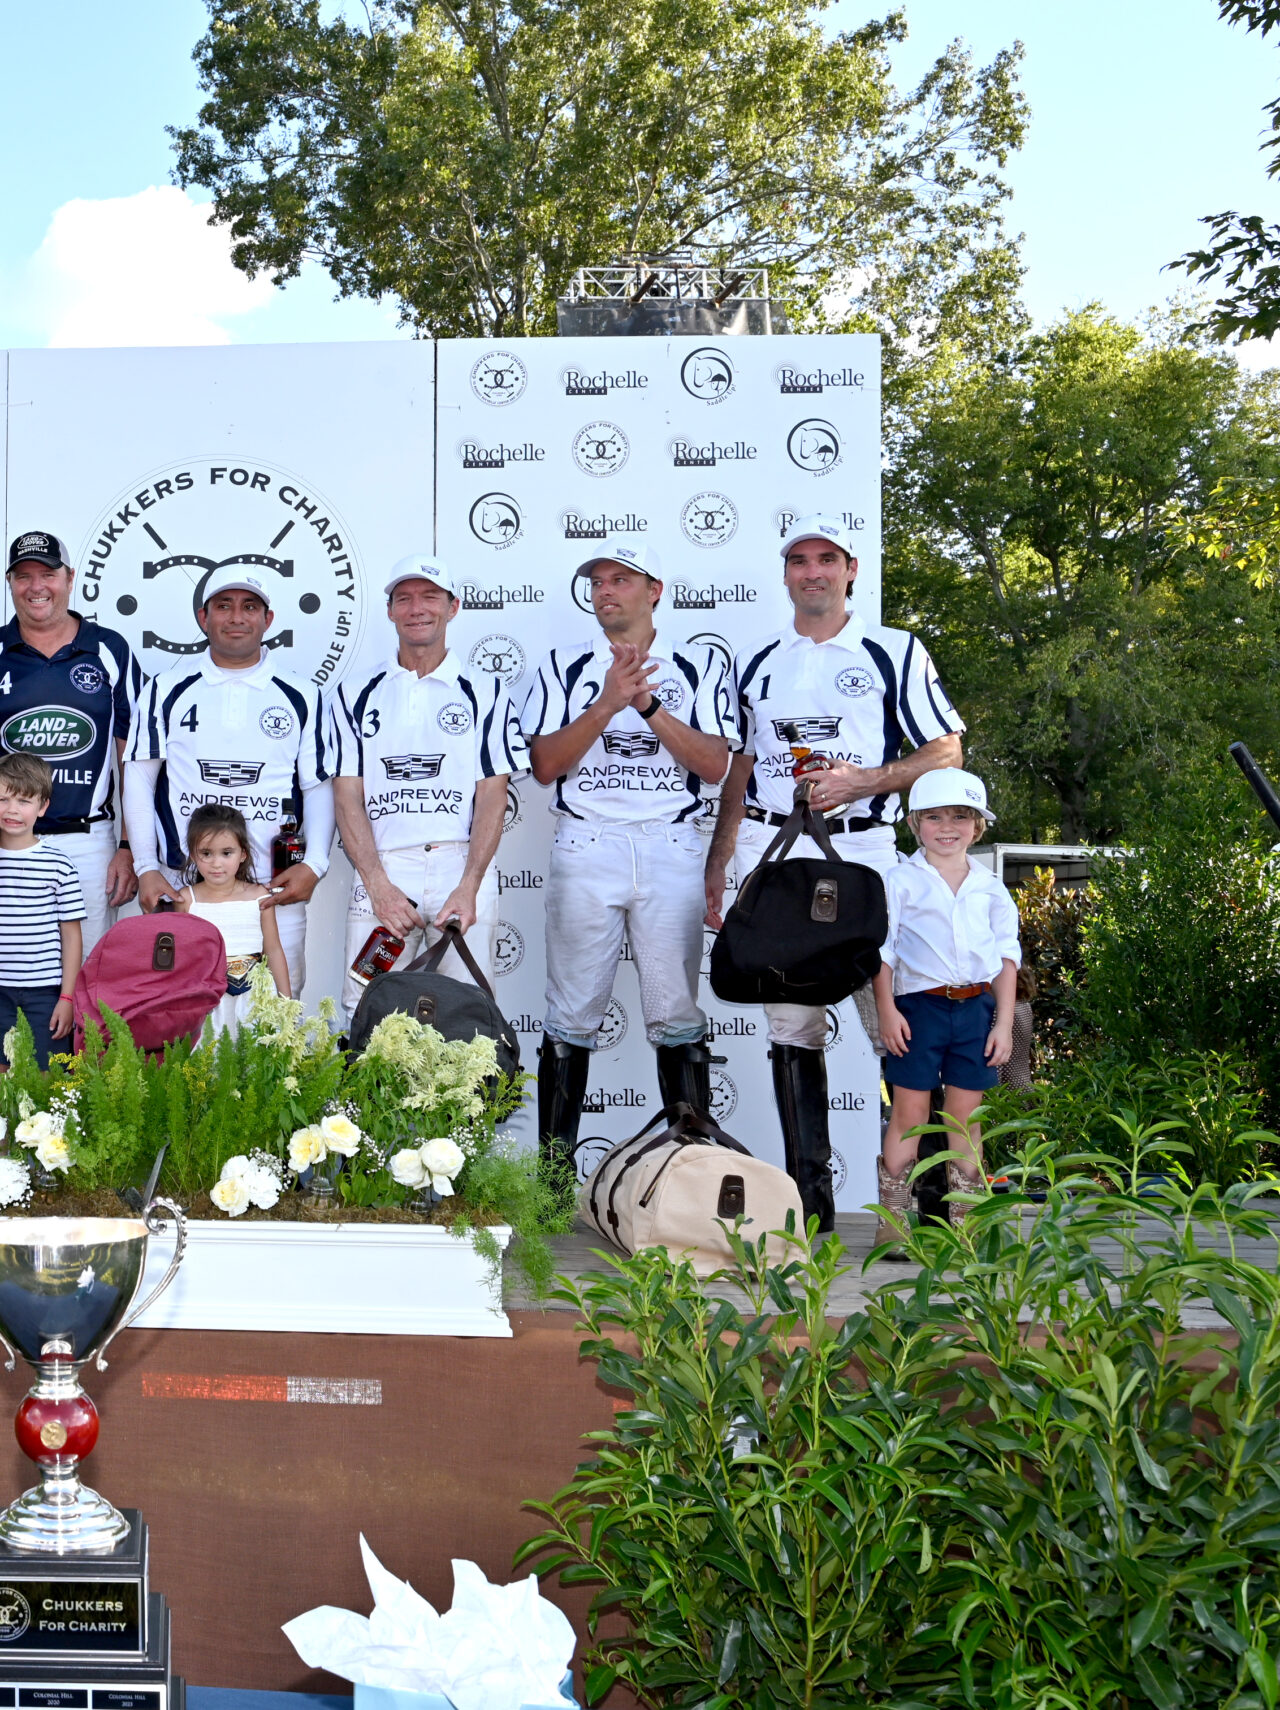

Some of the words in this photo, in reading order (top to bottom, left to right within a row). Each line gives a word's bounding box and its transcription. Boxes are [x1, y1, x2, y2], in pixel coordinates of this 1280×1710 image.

[567, 371, 648, 388] Rochelle
[782, 369, 864, 386] Rochelle
[706, 394, 727, 406] Saddle
[464, 444, 544, 461] Rochelle
[675, 442, 757, 459] Rochelle
[813, 466, 835, 478] Saddle
[721, 497, 736, 520] CHARITY
[566, 514, 647, 531] Rochelle
[82, 472, 193, 602] CHUKKERS
[210, 467, 271, 492] FOR
[278, 486, 355, 601] CHARITY
[18, 548, 48, 556] NASHVILLE
[494, 539, 516, 551] Saddle
[463, 585, 544, 602] Rochelle
[674, 585, 756, 602] Rochelle
[311, 641, 346, 687] DDLE
[336, 611, 352, 637] UP!
[509, 640, 524, 662] CHARITY
[581, 681, 600, 710] 2
[758, 674, 771, 701] 1
[931, 677, 956, 713] 1
[719, 687, 735, 722] 2
[18, 717, 66, 732] LAND
[180, 704, 199, 732] 4
[363, 709, 380, 738] 3
[20, 732, 80, 748] ROVER
[508, 717, 526, 751] 3
[51, 769, 93, 785] VILLE
[577, 764, 681, 778] ANDREWS
[578, 779, 686, 792] CADILLAC
[180, 792, 279, 808] ANDREWS
[367, 789, 463, 806] ANDREWS
[369, 803, 460, 821] CADILLAC
[497, 870, 543, 888] helle
[610, 999, 626, 1023] CHARITY
[510, 1014, 542, 1032] elle
[709, 1017, 756, 1035] helle
[830, 1093, 865, 1111] elle
[832, 1151, 845, 1172] HARITY
[42, 1598, 124, 1612] CHUKKERS
